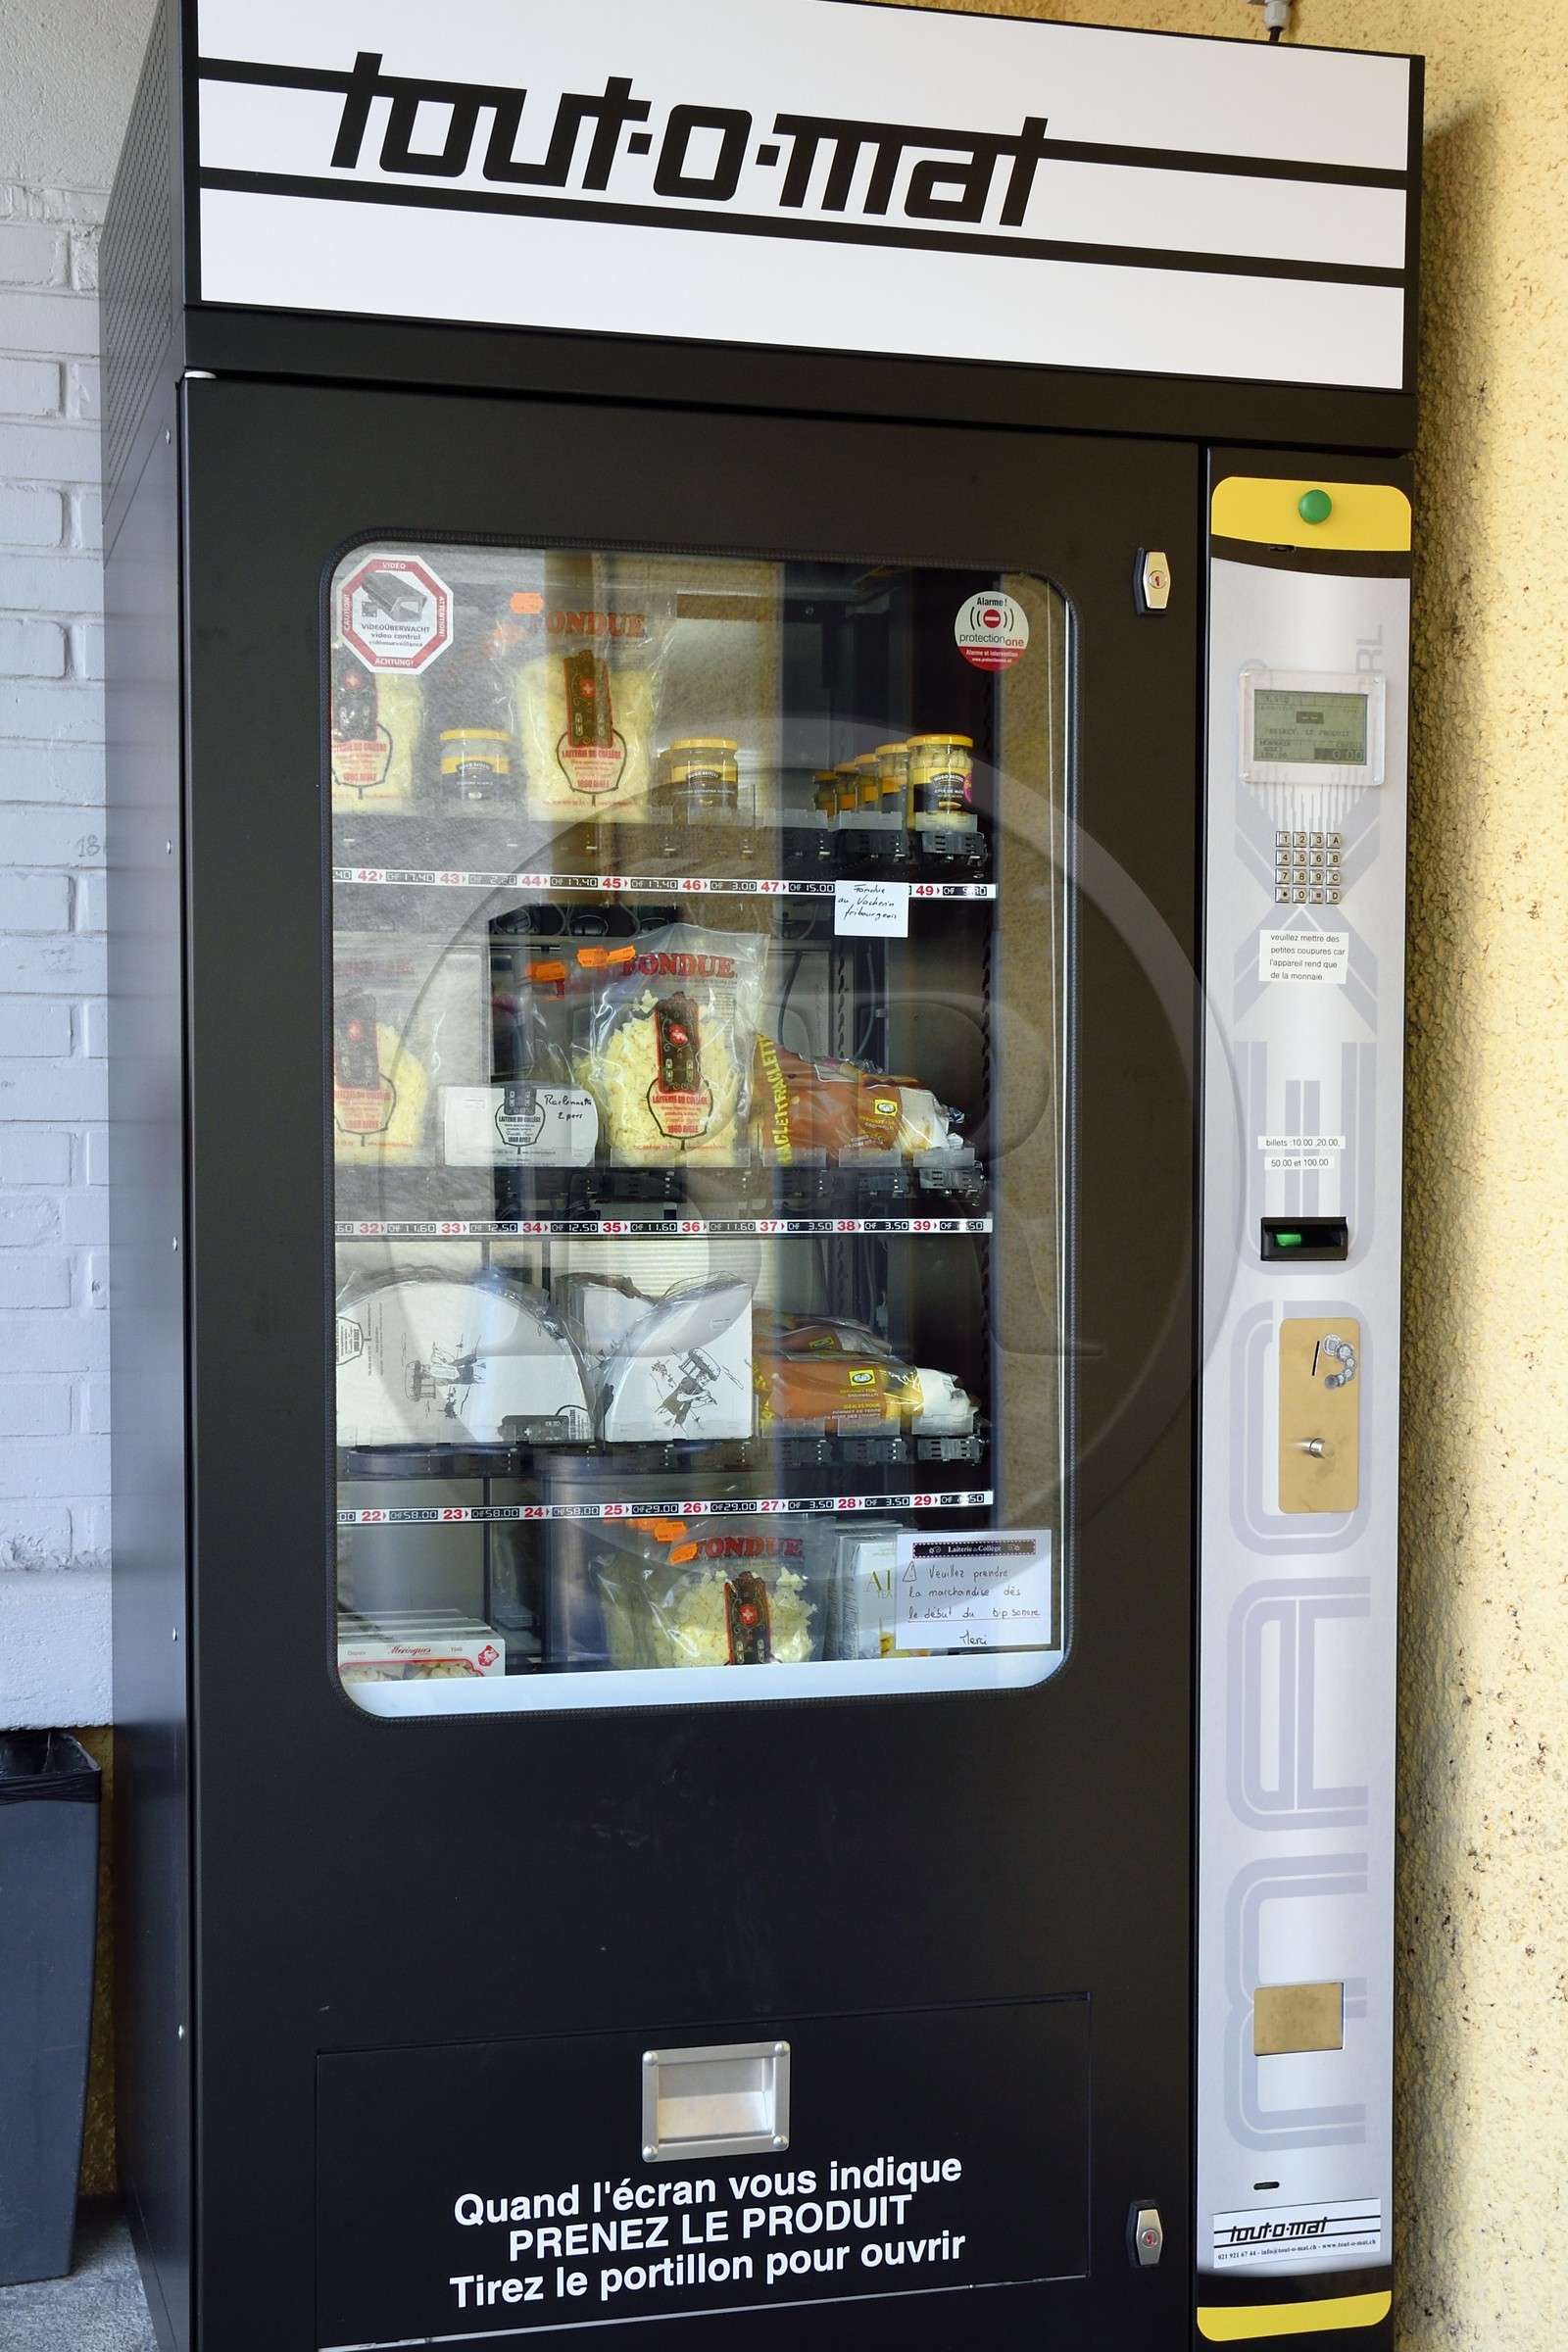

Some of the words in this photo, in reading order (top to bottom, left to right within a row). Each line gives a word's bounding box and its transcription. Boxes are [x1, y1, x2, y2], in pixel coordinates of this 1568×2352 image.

[976, 597, 1004, 607] Alarme
[361, 623, 430, 633] VIDEOÜBERWACHT
[530, 610, 646, 637] ONDUE
[374, 658, 414, 666] ACHTUNG!
[358, 870, 378, 882] 42
[441, 873, 461, 884] 43
[521, 875, 542, 886] 44
[568, 877, 598, 887] 17.40
[602, 877, 621, 889] 45
[649, 880, 677, 889] 17.40
[682, 879, 702, 890] 46
[731, 882, 757, 891] 3.00
[760, 881, 779, 892] 47
[806, 884, 834, 893] 15.00
[915, 885, 934, 896] 49
[1270, 947, 1296, 956] petites
[1270, 958, 1303, 968] l'appareil
[1291, 972, 1325, 981] monnaie.
[1304, 1158, 1329, 1167] 100.00
[360, 1223, 379, 1234] 32
[441, 1223, 461, 1234] 33
[488, 1224, 517, 1233] 12.50
[522, 1222, 542, 1234] 34
[568, 1224, 598, 1233] 12.50
[603, 1222, 621, 1233] 35
[681, 1222, 701, 1233] 36
[760, 1221, 778, 1232] 37
[808, 1221, 833, 1231] 3.50
[837, 1220, 856, 1231] 38
[885, 1221, 908, 1230] 3.50
[912, 1220, 931, 1231] 39
[362, 1510, 381, 1522] 22
[443, 1508, 463, 1520] 23
[524, 1507, 544, 1518] 24
[604, 1504, 623, 1516] 25
[683, 1502, 702, 1514] 26
[760, 1500, 779, 1511] 27
[808, 1499, 833, 1509] 3.50
[838, 1497, 857, 1509] 28
[886, 1497, 909, 1507] 3.50
[913, 1495, 932, 1506] 29
[978, 1544, 1002, 1553] Collège
[929, 1564, 964, 1579] Veuillez
[973, 1566, 1008, 1583] prendre
[908, 1586, 922, 1598] la
[928, 1587, 990, 1596] marchandise
[908, 1605, 918, 1619] le
[961, 1606, 975, 1618] du
[992, 1607, 1007, 1620] bip
[959, 1630, 988, 1645] Merci
[388, 1645, 431, 1656] Meringues
[454, 2183, 579, 2227] Quand
[593, 2178, 716, 2214] l'écran
[728, 2170, 816, 2200] vous
[830, 2156, 962, 2192] indique
[510, 2216, 669, 2262] PRENEZ
[682, 2211, 729, 2245] LE
[743, 2194, 912, 2239] PRODUIT
[450, 2275, 545, 2308] Tirez
[557, 2267, 588, 2298] le
[601, 2252, 754, 2300] portillon
[766, 2243, 850, 2284] pour
[860, 2231, 966, 2268] ouvrir
